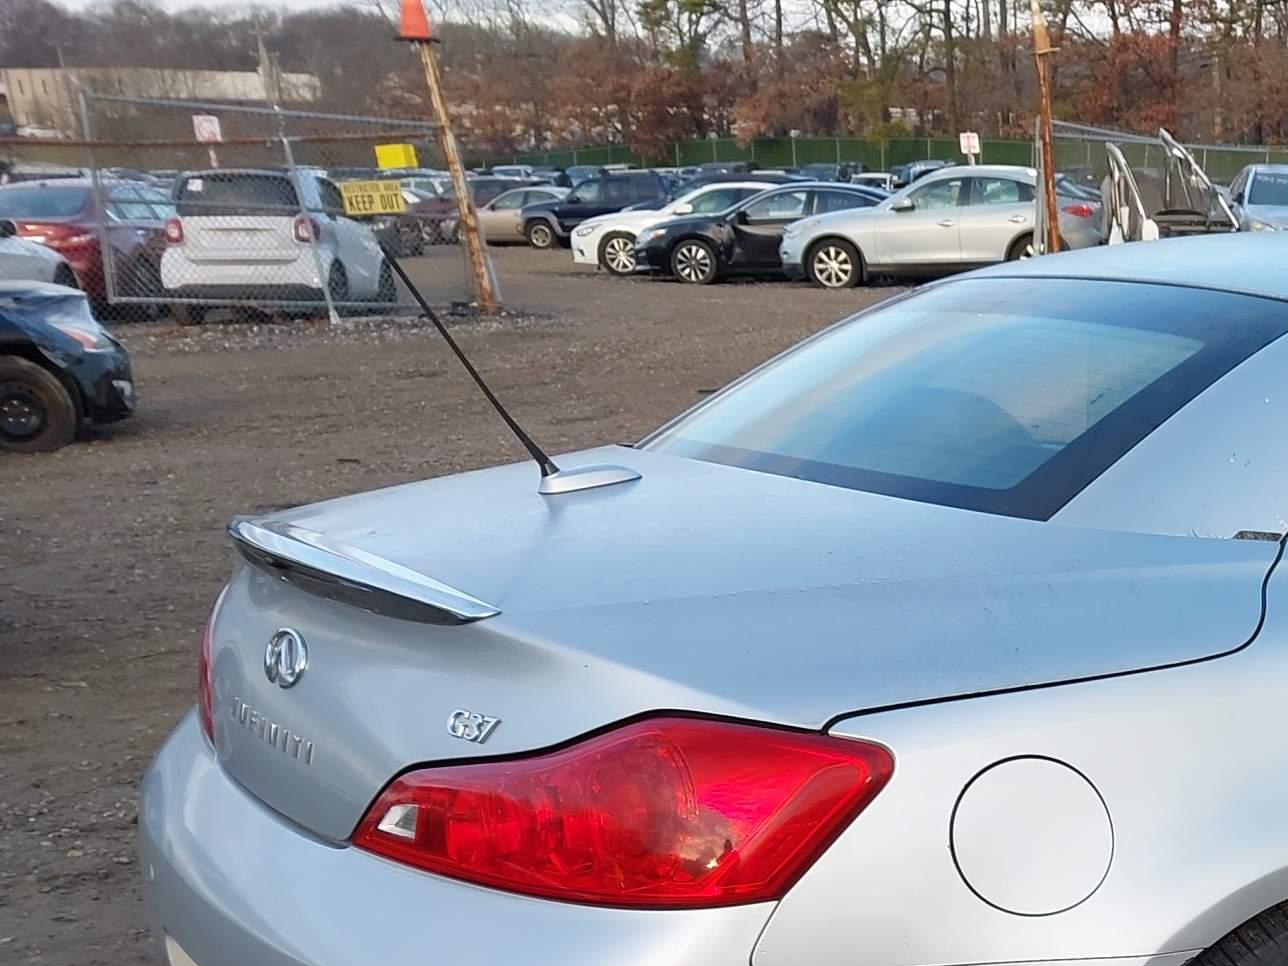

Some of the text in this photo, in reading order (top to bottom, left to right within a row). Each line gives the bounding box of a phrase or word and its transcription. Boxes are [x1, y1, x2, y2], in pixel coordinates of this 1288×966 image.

[347, 193, 401, 211] KEEP OUT
[447, 709, 502, 745] G37
